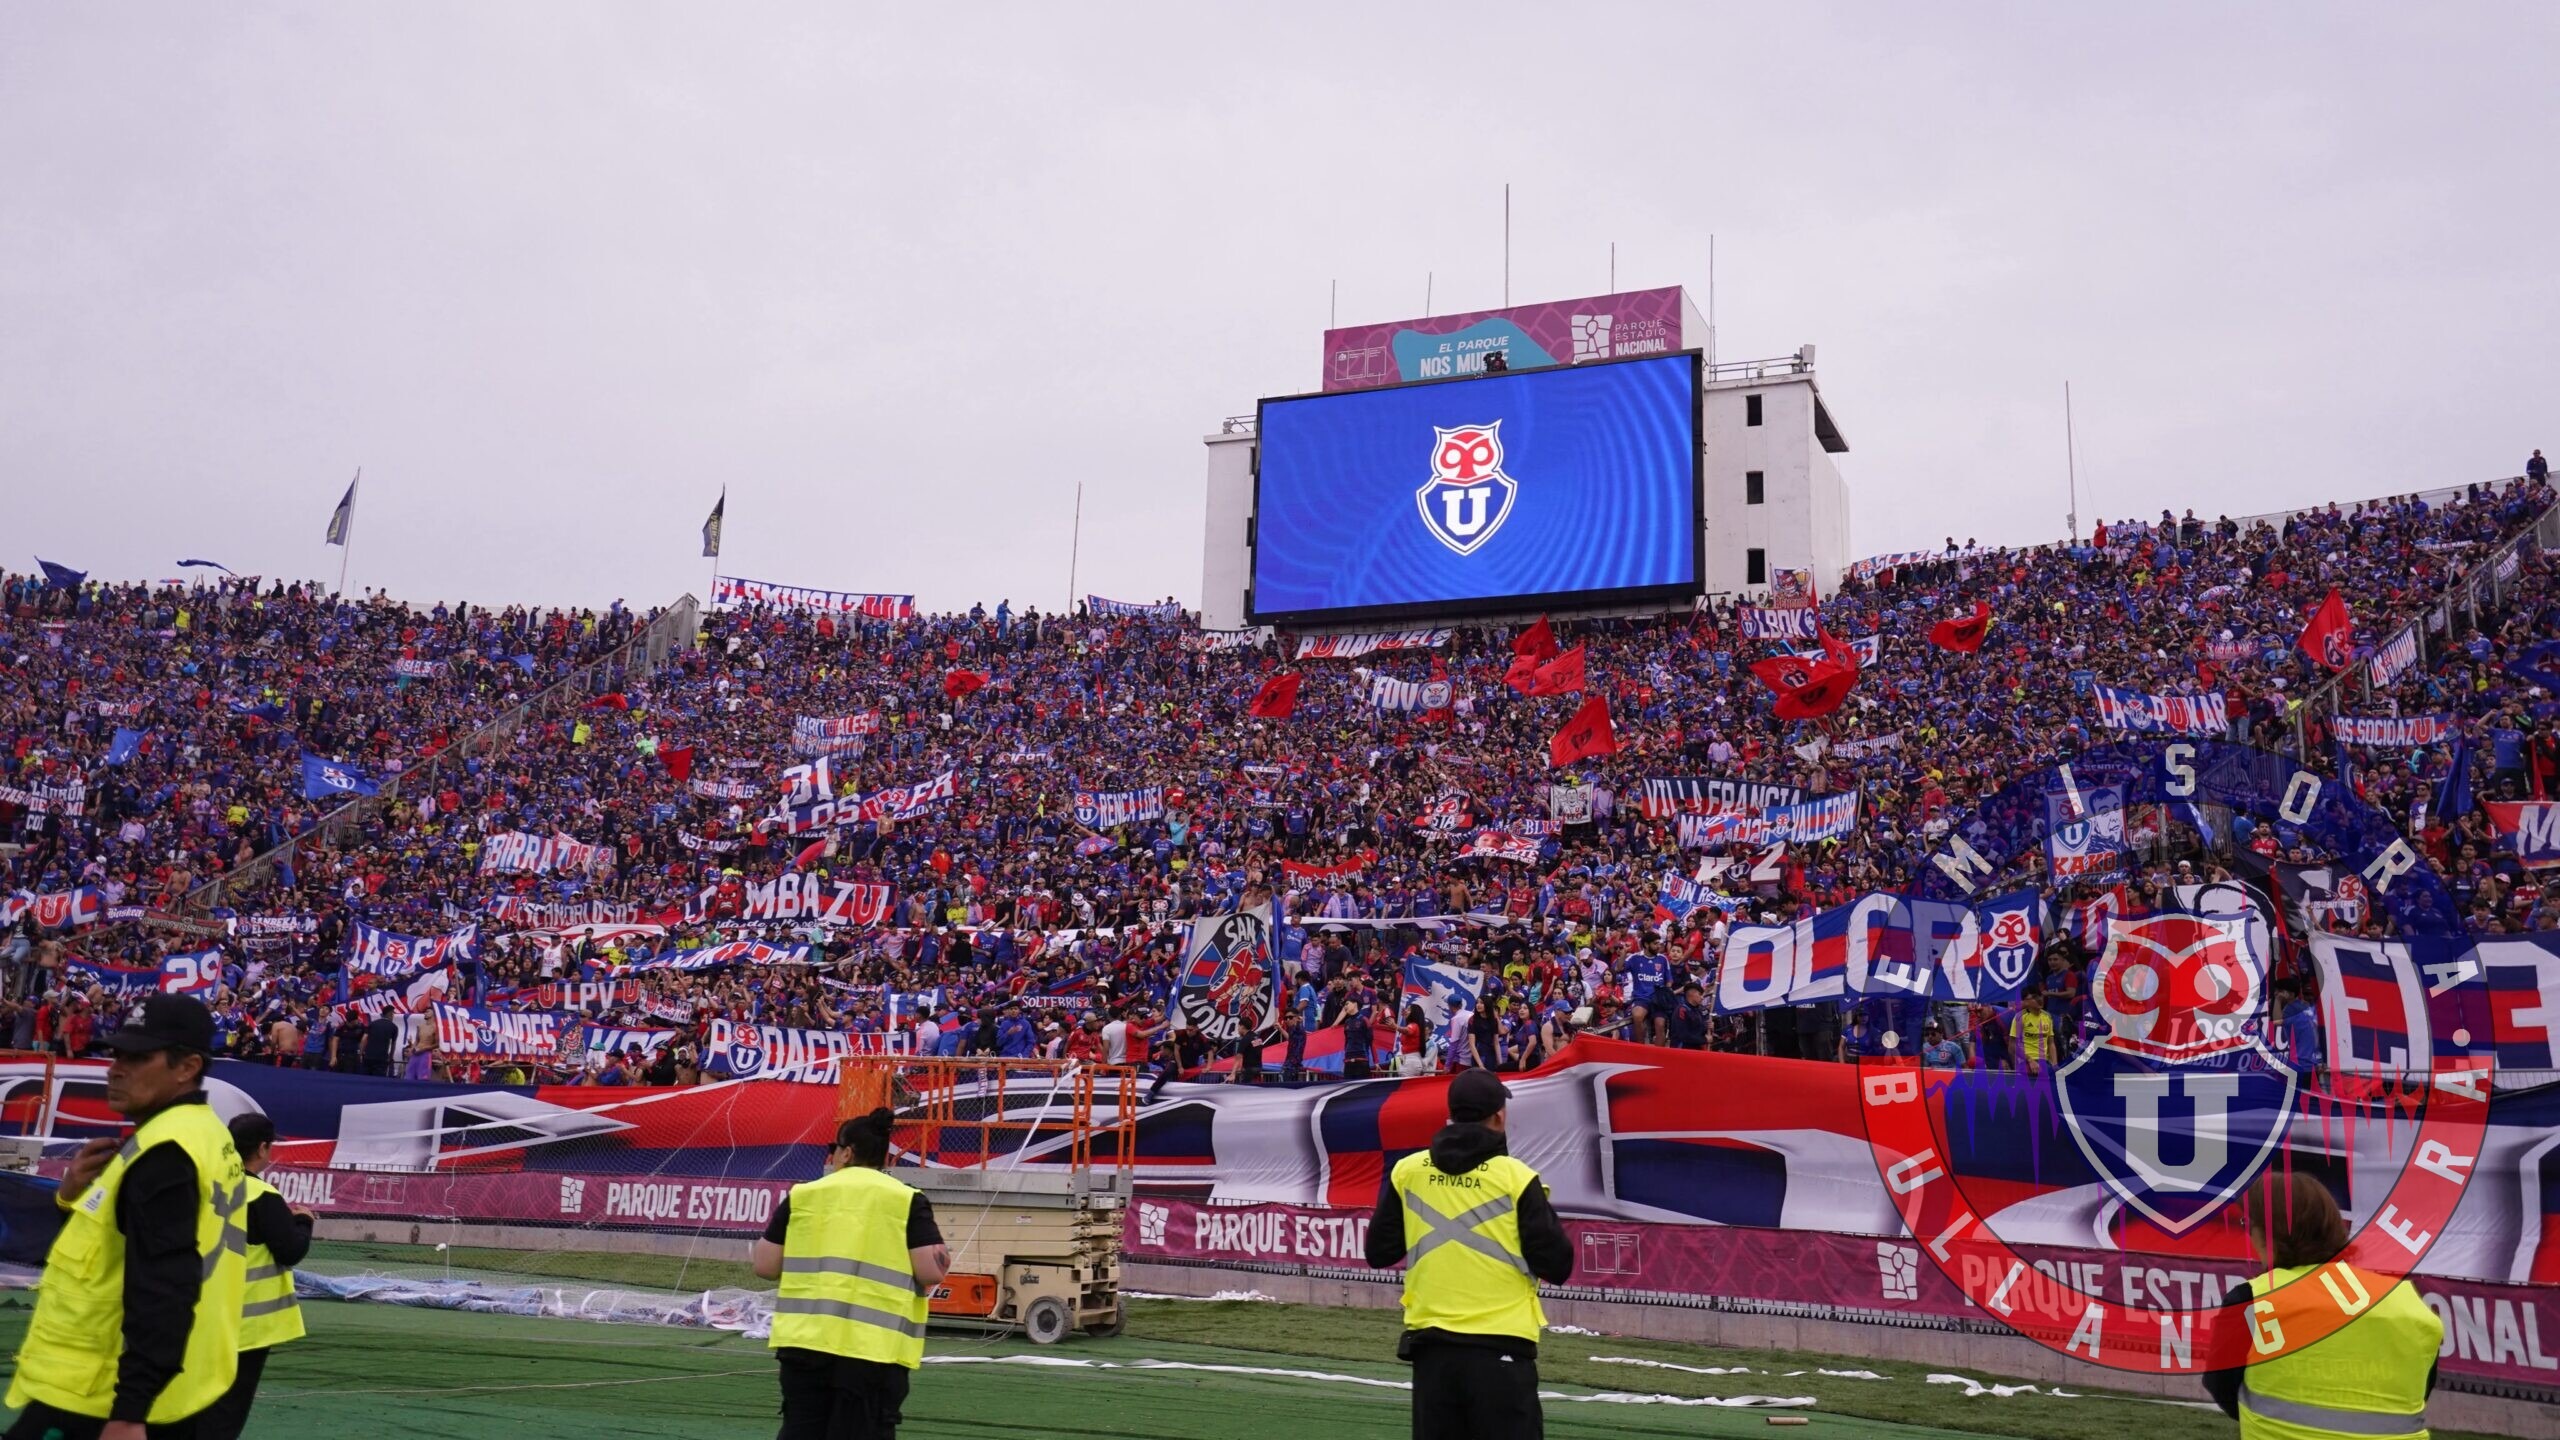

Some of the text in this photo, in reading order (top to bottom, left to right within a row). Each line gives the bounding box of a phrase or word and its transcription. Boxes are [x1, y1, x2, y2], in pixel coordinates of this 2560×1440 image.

[1615, 319, 1663, 333] PARQUE
[1615, 328, 1667, 341] ESTADIO
[1439, 336, 1509, 353] EL PARQUE
[1615, 338, 1667, 356] NACIONAL
[1420, 356, 1451, 377] NOS
[1442, 487, 1491, 536] U
[1296, 628, 1434, 660] PUDAHUEL
[1371, 676, 1419, 711] FDV
[2092, 684, 2128, 729] LA
[2332, 716, 2443, 746] LOS SOCIOAZUL
[29, 797, 48, 812] DE
[66, 801, 84, 816] MI
[1643, 778, 1702, 818] VILLA
[1525, 819, 1561, 836] BLUE
[1791, 791, 1858, 842] VALLEDOR
[2053, 851, 2117, 876] KAKO
[1662, 872, 1697, 901] BUIN
[1225, 915, 1257, 956] SAN
[1638, 973, 1661, 982] Claro
[564, 981, 616, 1011] LPV
[432, 1002, 479, 1054] LOS
[489, 1010, 557, 1056] ANDES
[257, 1170, 336, 1205] CIONAL
[1429, 1174, 1481, 1189] PRIVADA
[607, 1182, 771, 1223] PARQUE ESTADIO
[1195, 1211, 1369, 1260] PARQUE ESTAD
[1961, 1253, 2107, 1322] PARQUE
[2421, 1292, 2558, 1370] ONAL
